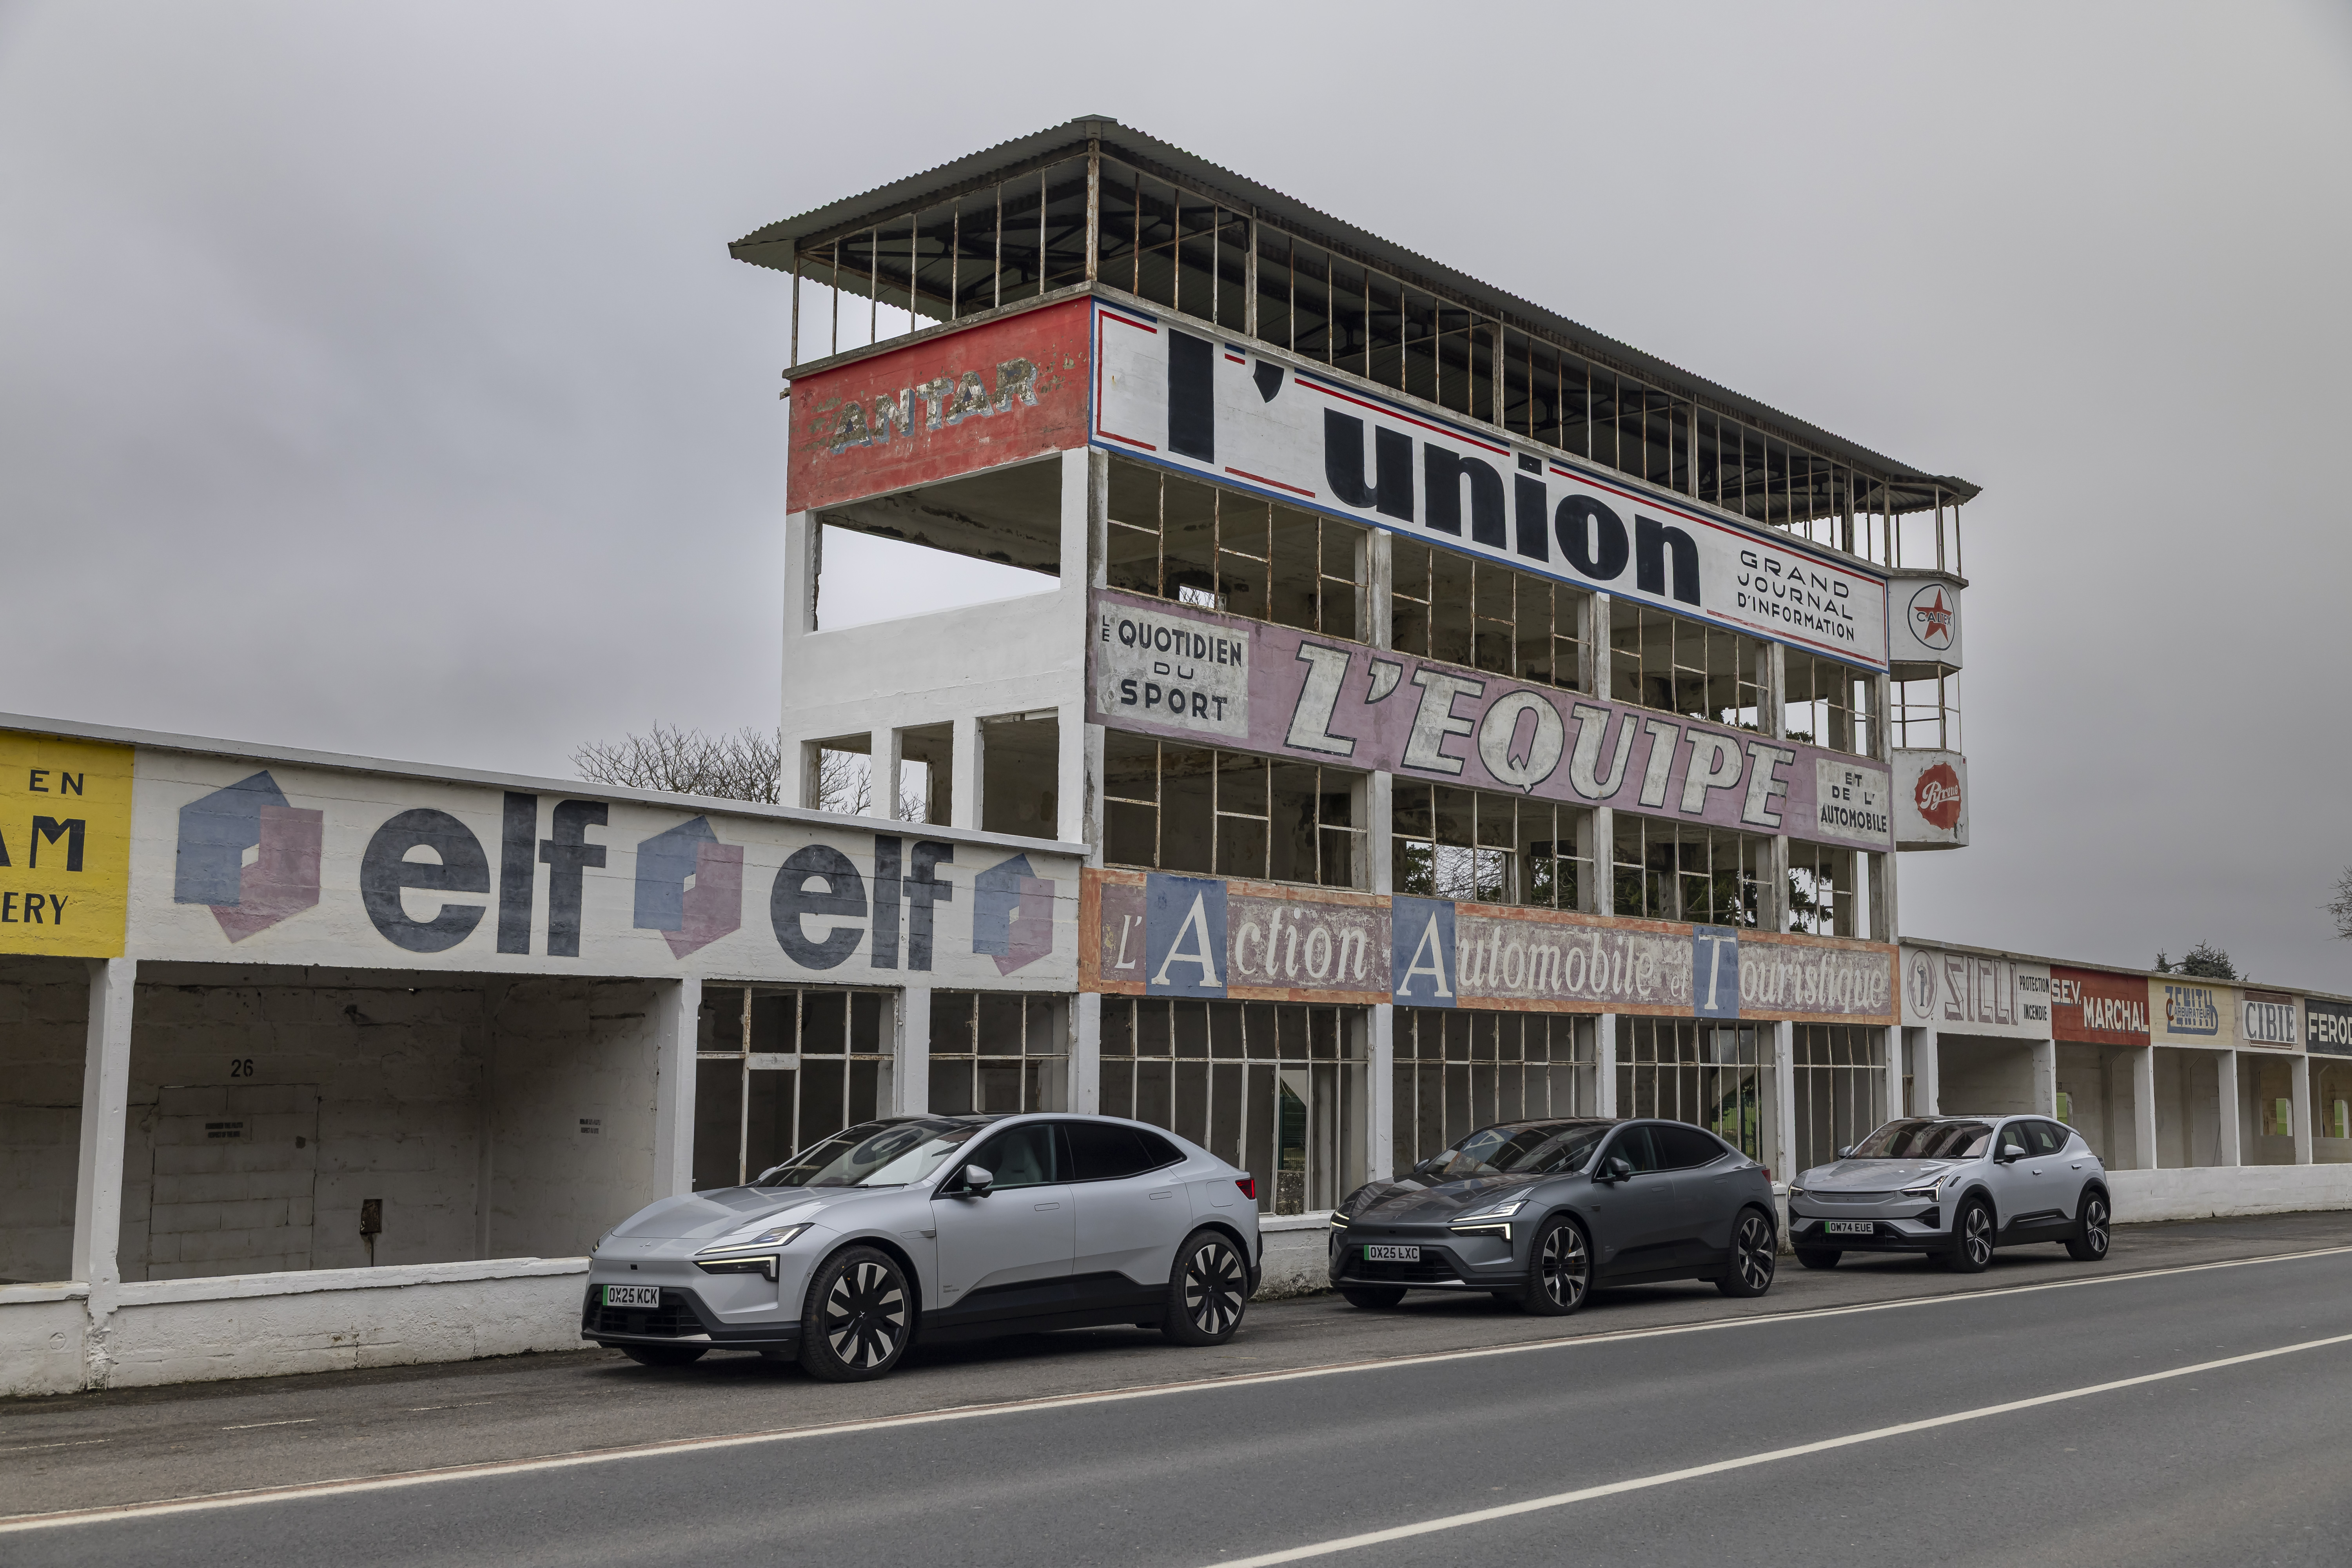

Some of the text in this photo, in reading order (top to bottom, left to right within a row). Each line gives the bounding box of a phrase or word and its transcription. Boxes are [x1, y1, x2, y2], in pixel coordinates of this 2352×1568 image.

[829, 357, 1039, 455] ANTAR
[1740, 550, 1849, 599] GRAND
[1737, 573, 1853, 621] JOURNAL
[1738, 591, 1854, 642] D'INFORMATION
[1916, 611, 1951, 627] CALTEX
[1118, 619, 1241, 668] QUOTIDIEN
[1154, 661, 1194, 680] DU
[1120, 679, 1227, 721] SPORT
[1283, 640, 1796, 829] L'EQUIPE
[29, 769, 83, 795] EN
[1831, 785, 1850, 801] DE
[1845, 771, 1862, 787] ET
[1920, 781, 1959, 810] Pyrene
[1820, 804, 1887, 833] AUTOMOBILE
[360, 791, 609, 957] elf
[770, 835, 954, 971] elf
[1397, 911, 1653, 998] Automobile
[1699, 935, 1882, 1013] Touristique
[1944, 953, 2018, 1025] SICLI
[2019, 975, 2049, 993] PROTECTION
[2051, 979, 2082, 1006] S.E.V.
[2024, 1004, 2047, 1021] INCENDIE
[2083, 996, 2149, 1033] MARCHAL
[2166, 998, 2210, 1021] CARBURATEUR
[230, 1059, 254, 1077] 26
[1831, 1223, 1872, 1232] OW74 EUE
[1370, 1247, 1418, 1259] OX25 LXC
[609, 1287, 657, 1304] OX25 KCK
